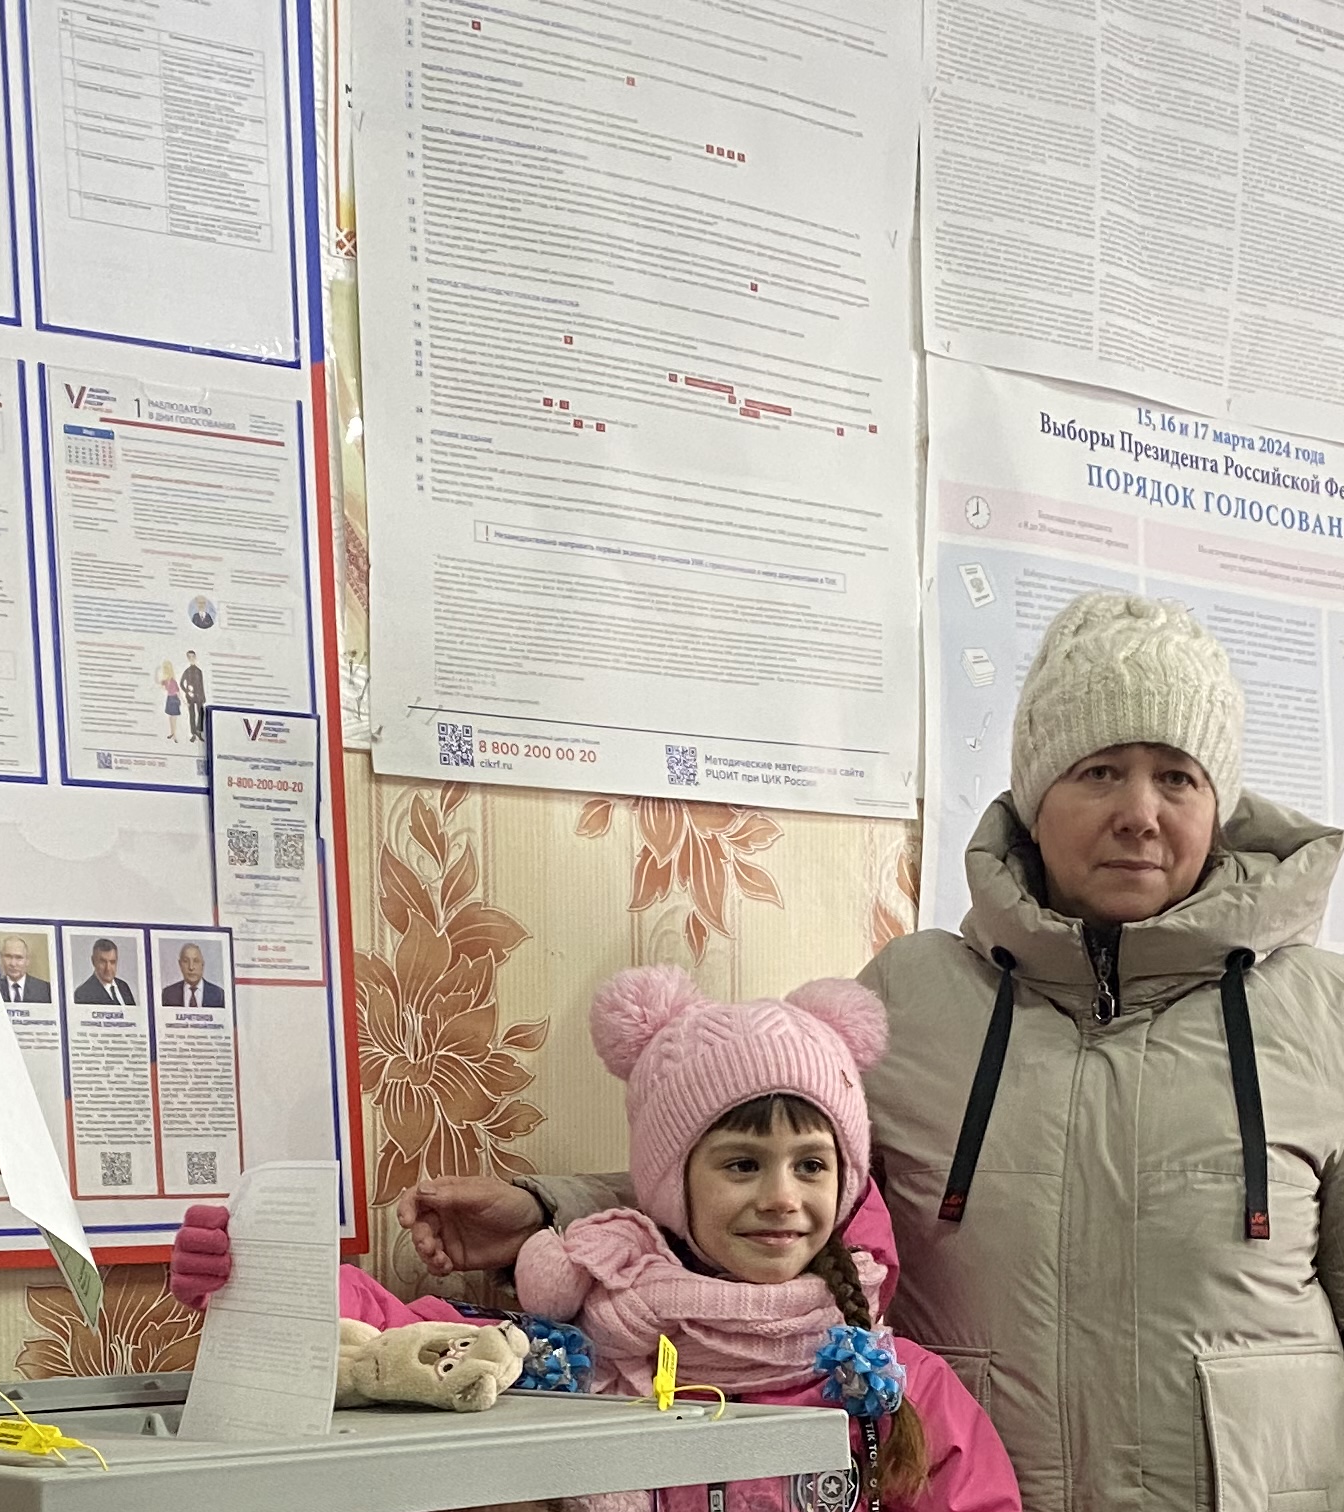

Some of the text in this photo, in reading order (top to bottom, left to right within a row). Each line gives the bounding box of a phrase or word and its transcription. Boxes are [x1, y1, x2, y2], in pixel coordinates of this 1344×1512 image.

[1137, 407, 1325, 466] 15, 16 и 17 марта 2024 года
[1040, 411, 1115, 451] Выборы
[1120, 431, 1218, 473] Президента
[1224, 455, 1320, 495] Российской
[1087, 463, 1196, 510] ПОРЯДОК
[479, 740, 597, 763] 8 800 200 00 20
[479, 759, 513, 770] cikrf.ru
[704, 754, 772, 770] Методические
[840, 767, 865, 778] сайте
[227, 776, 303, 792] 8-800-200-00-20
[706, 769, 739, 782] РЦОИТ
[742, 773, 759, 783] при
[761, 774, 782, 786] ЦИК
[864, 1421, 876, 1442] TIK
